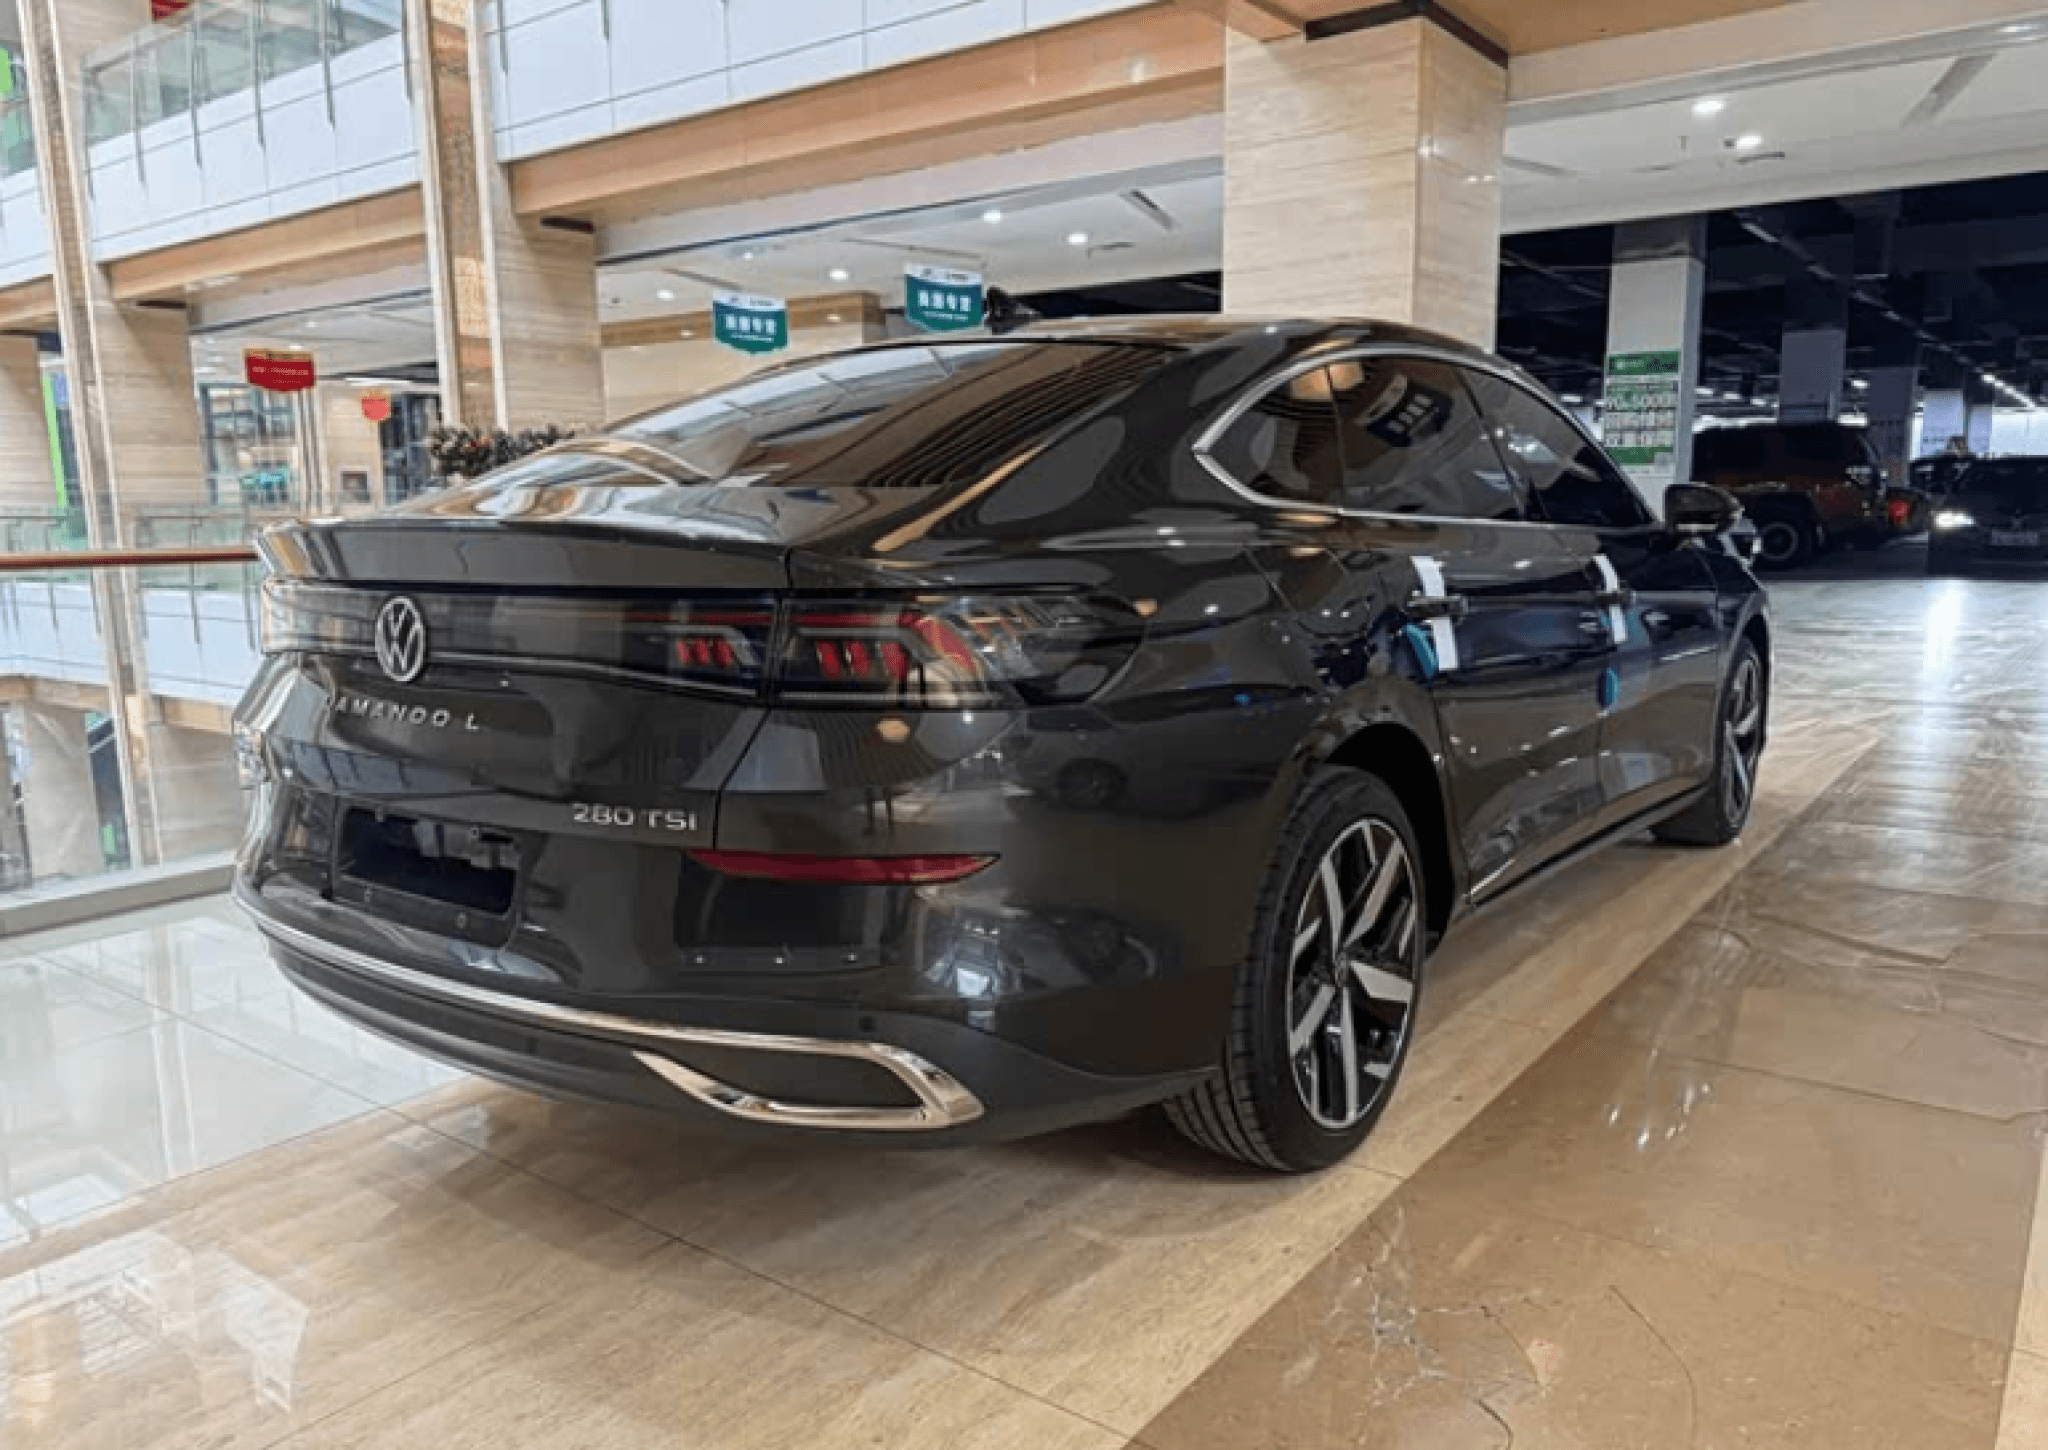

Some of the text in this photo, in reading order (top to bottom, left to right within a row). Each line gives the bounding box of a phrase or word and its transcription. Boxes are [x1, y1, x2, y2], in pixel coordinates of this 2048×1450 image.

[465, 712, 480, 730] L
[573, 803, 698, 831] 280 TSI
